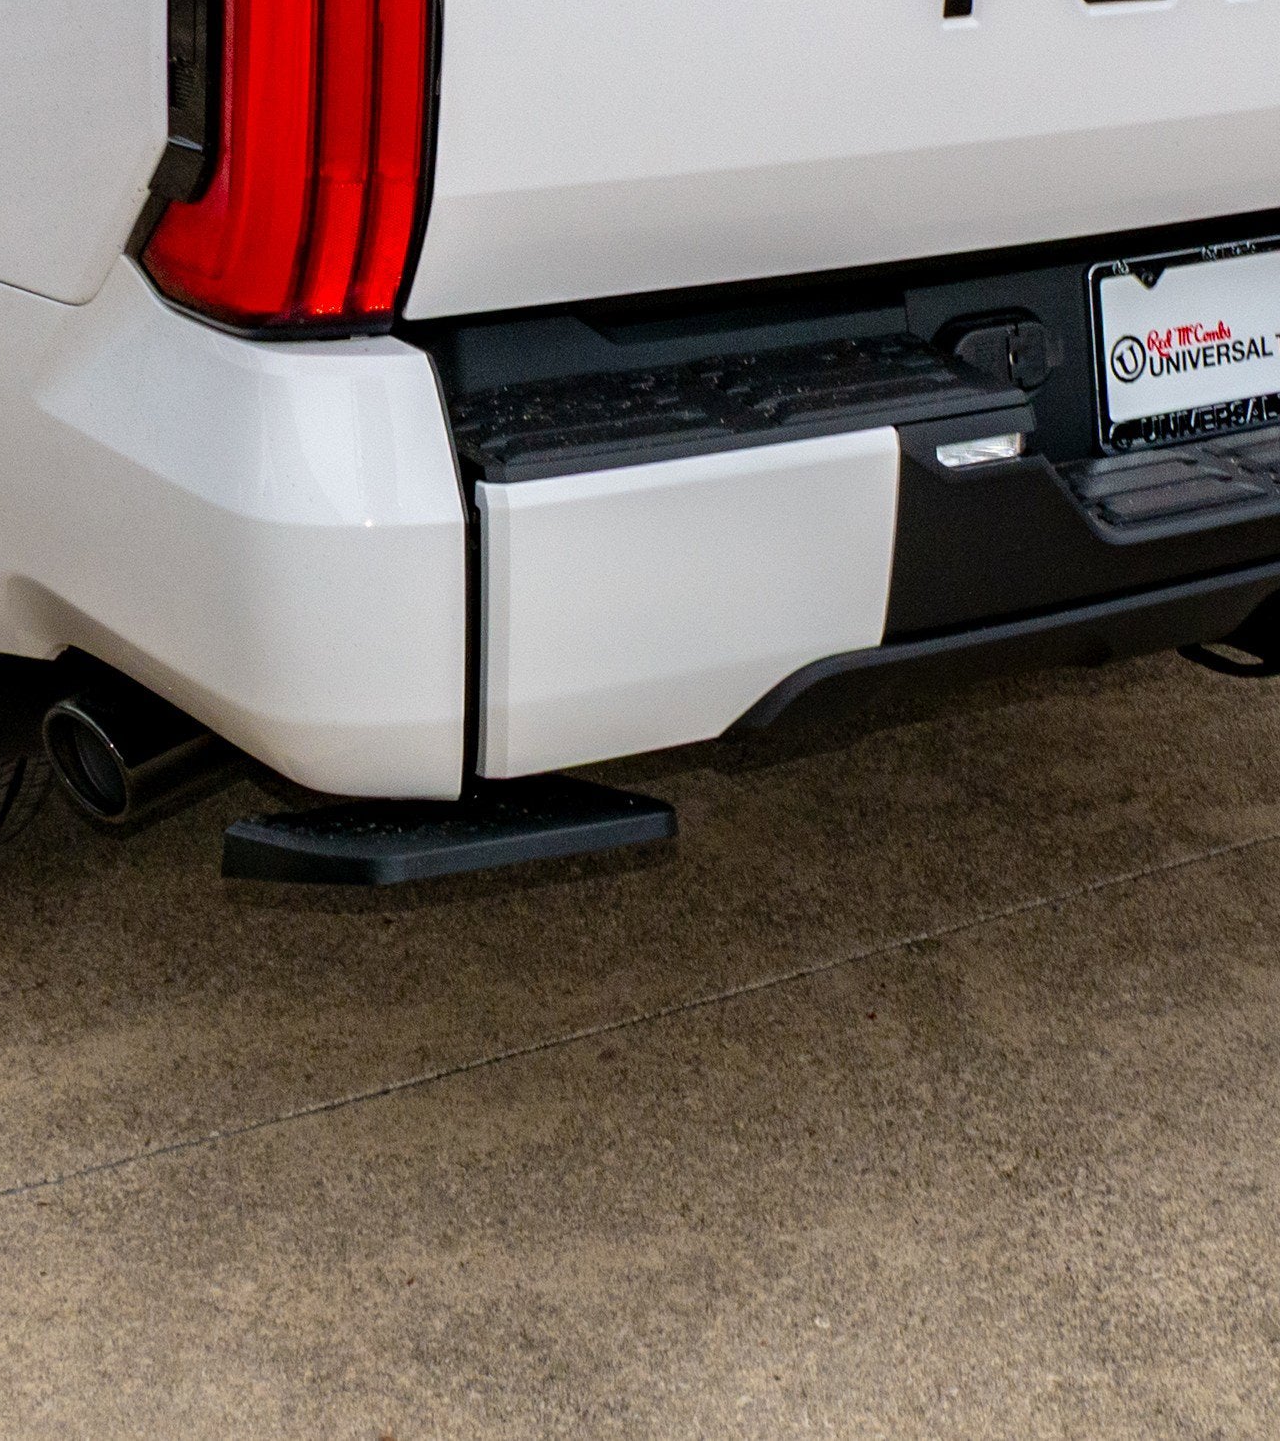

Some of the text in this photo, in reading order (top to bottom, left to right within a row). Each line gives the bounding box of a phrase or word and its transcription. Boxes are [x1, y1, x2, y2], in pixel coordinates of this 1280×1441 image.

[1147, 330, 1172, 357] Red
[1149, 339, 1274, 377] UNIVERSAL
[1141, 397, 1278, 442] UNIVERSAL
